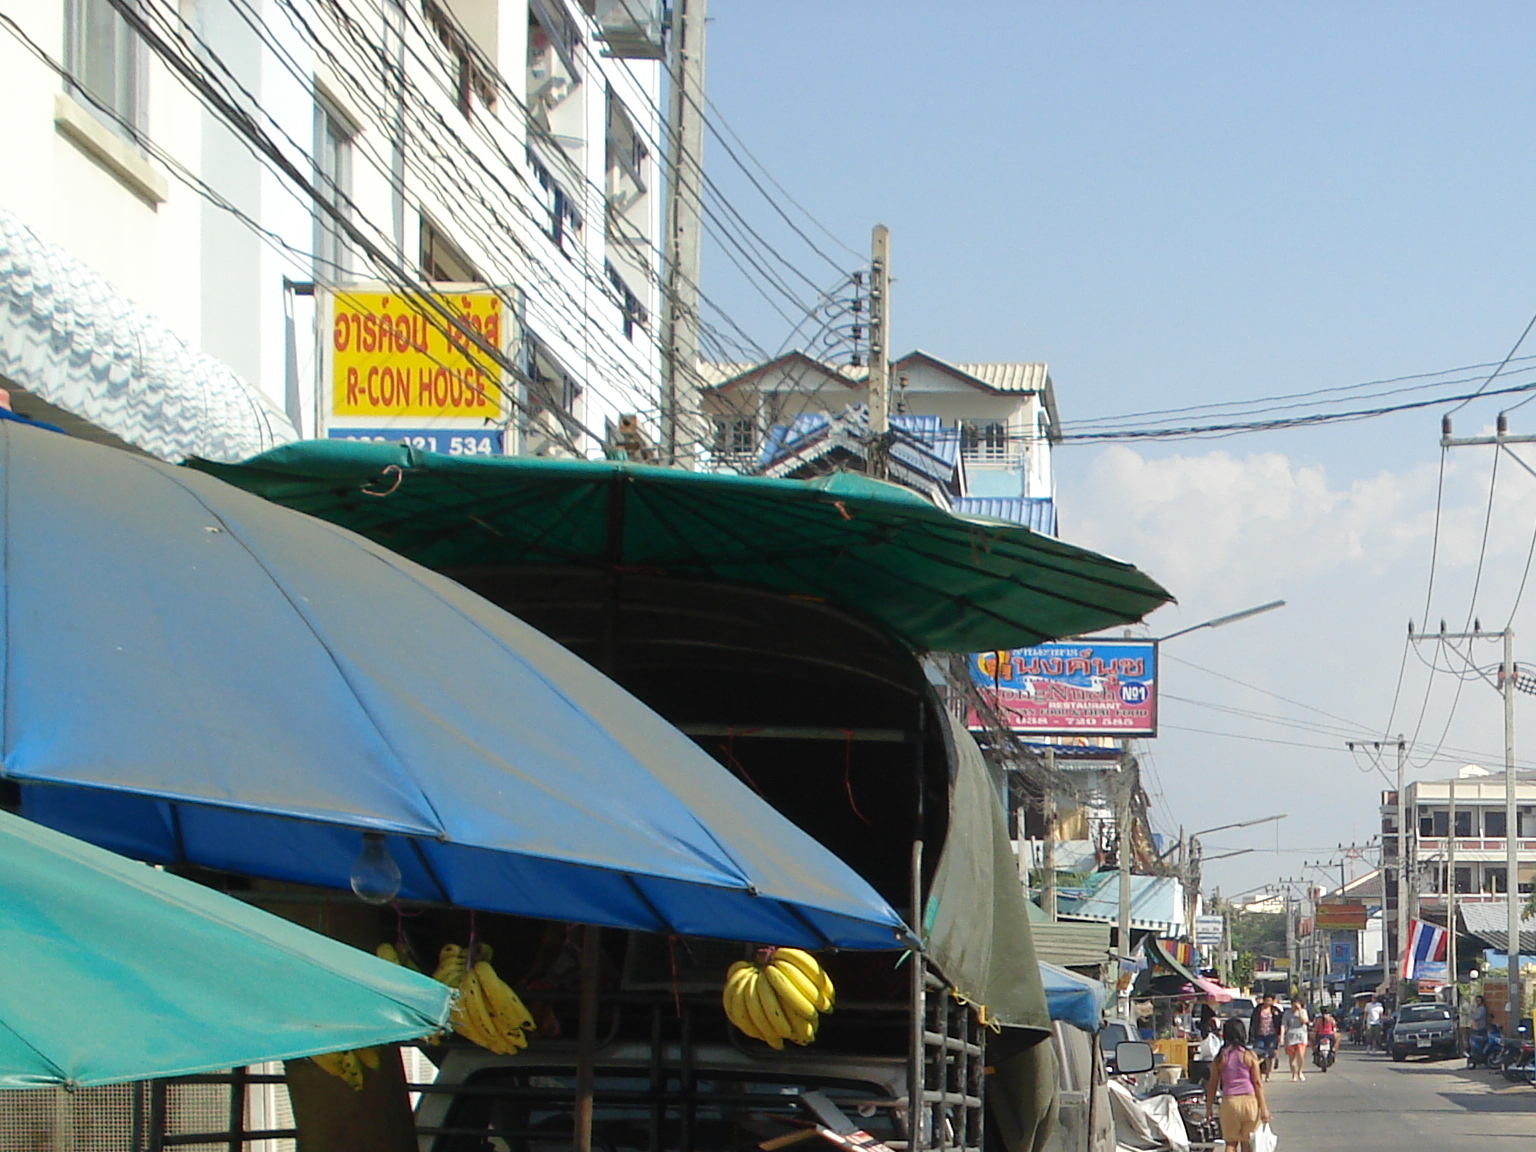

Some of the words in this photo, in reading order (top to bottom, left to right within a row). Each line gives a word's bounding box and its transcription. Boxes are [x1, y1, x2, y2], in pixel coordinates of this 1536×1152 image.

[347, 366, 410, 407] R-CON
[419, 366, 486, 407] HOUSE
[449, 437, 493, 455] 534
[1048, 701, 1122, 710] RESTAURANT
[1116, 709, 1148, 717] FOOD
